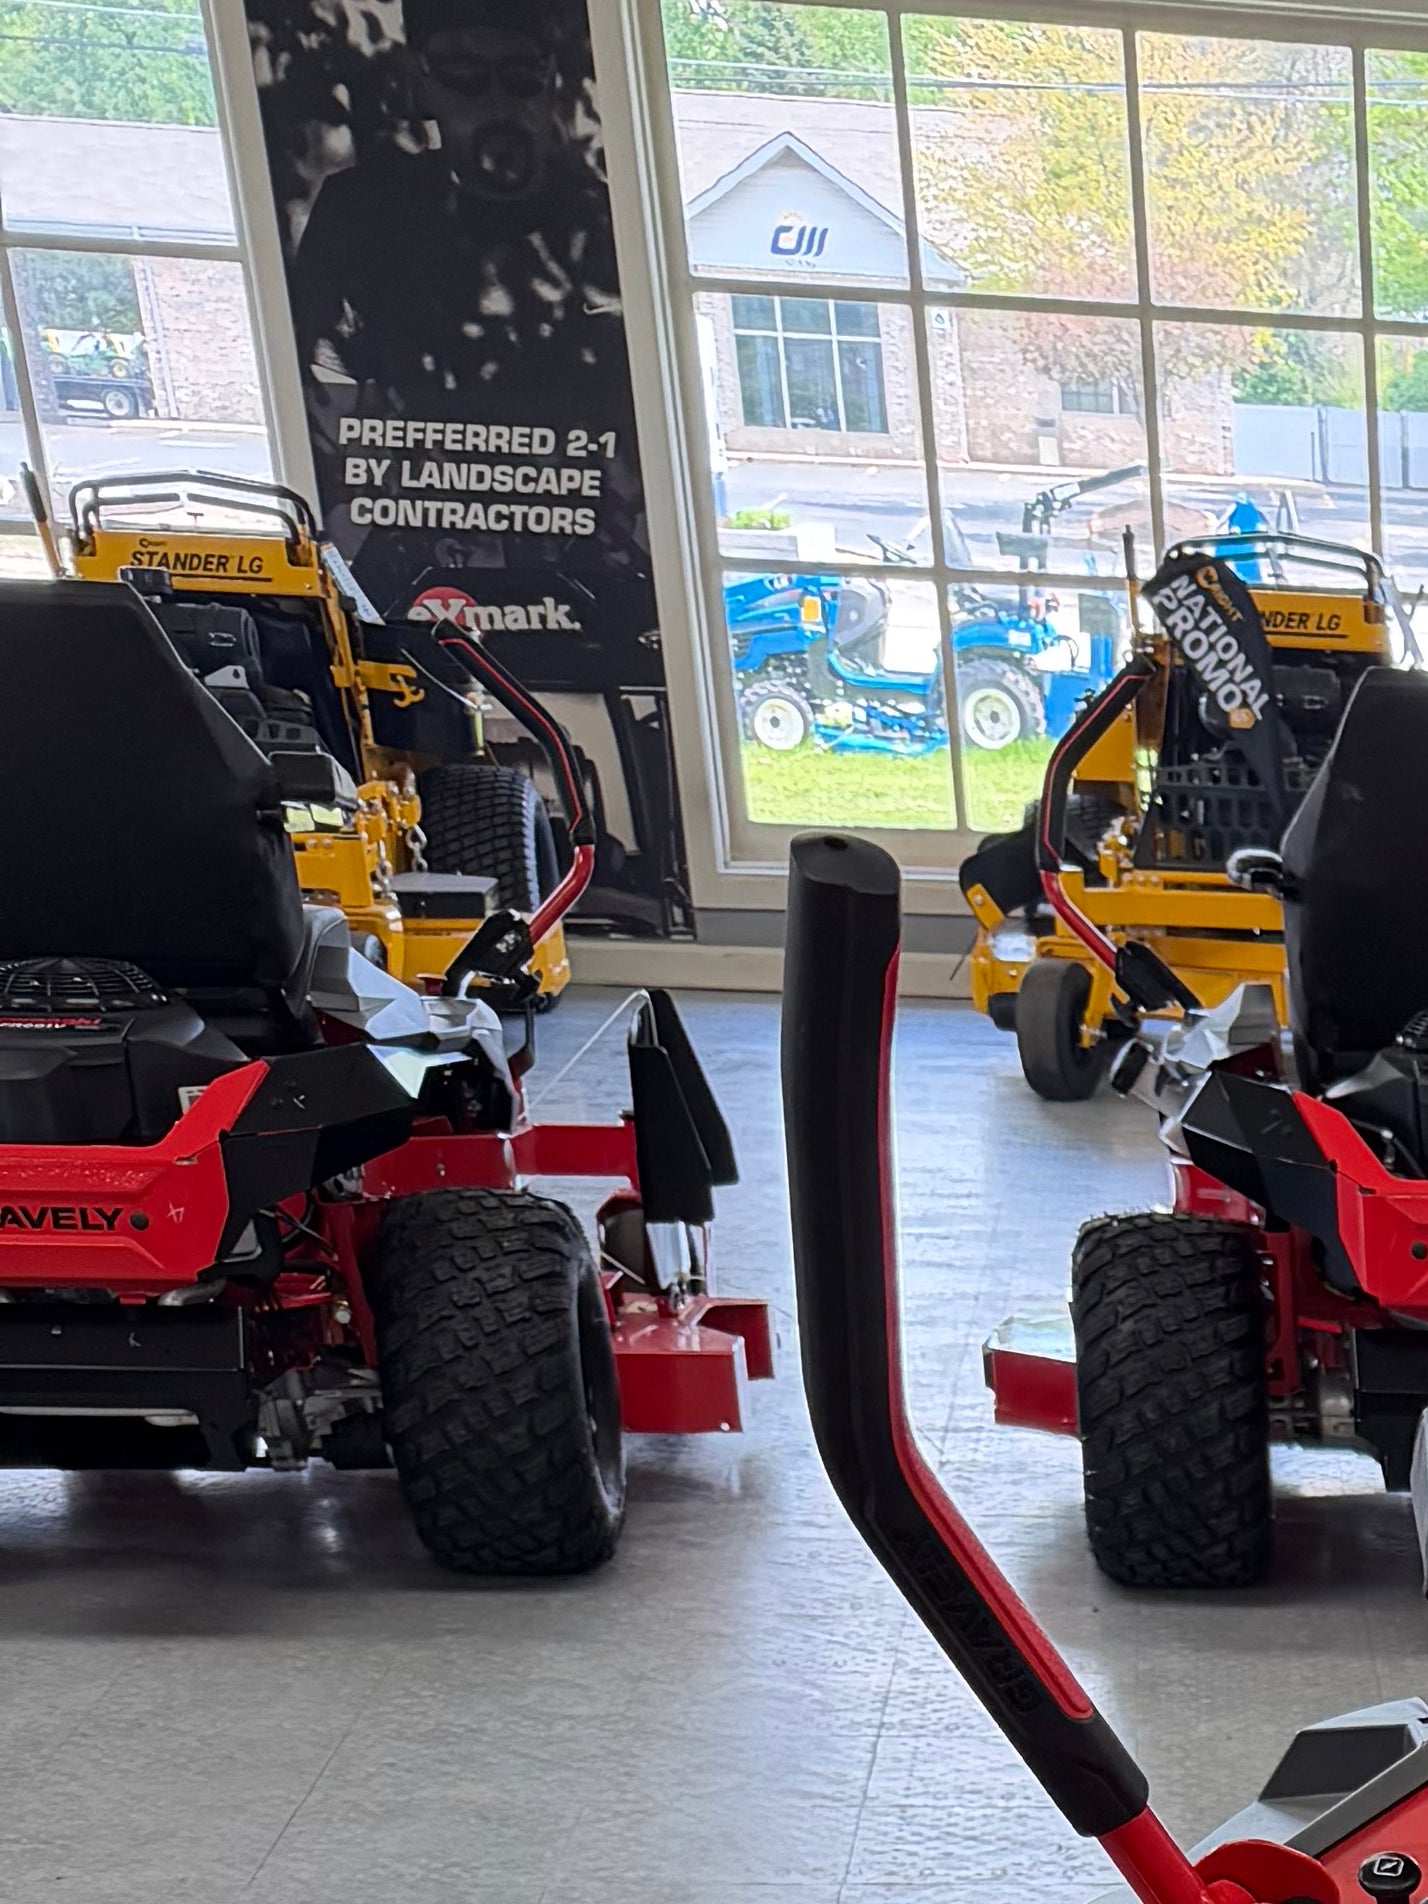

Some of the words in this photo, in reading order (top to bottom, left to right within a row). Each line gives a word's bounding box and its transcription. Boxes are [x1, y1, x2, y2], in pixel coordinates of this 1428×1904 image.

[338, 417, 556, 456] PREFFERRED
[565, 429, 617, 459] 2-1
[344, 457, 392, 487] BY
[400, 460, 602, 497] LANDSCAPE
[349, 496, 597, 536] CONTRACTORS
[131, 550, 228, 574] STANDER
[236, 554, 264, 575] LG
[1259, 611, 1309, 631] NDER
[1315, 613, 1342, 632] LG
[1153, 586, 1243, 713] PROMO
[1171, 574, 1270, 722] NATIONAL
[0, 1205, 123, 1231] AVELY
